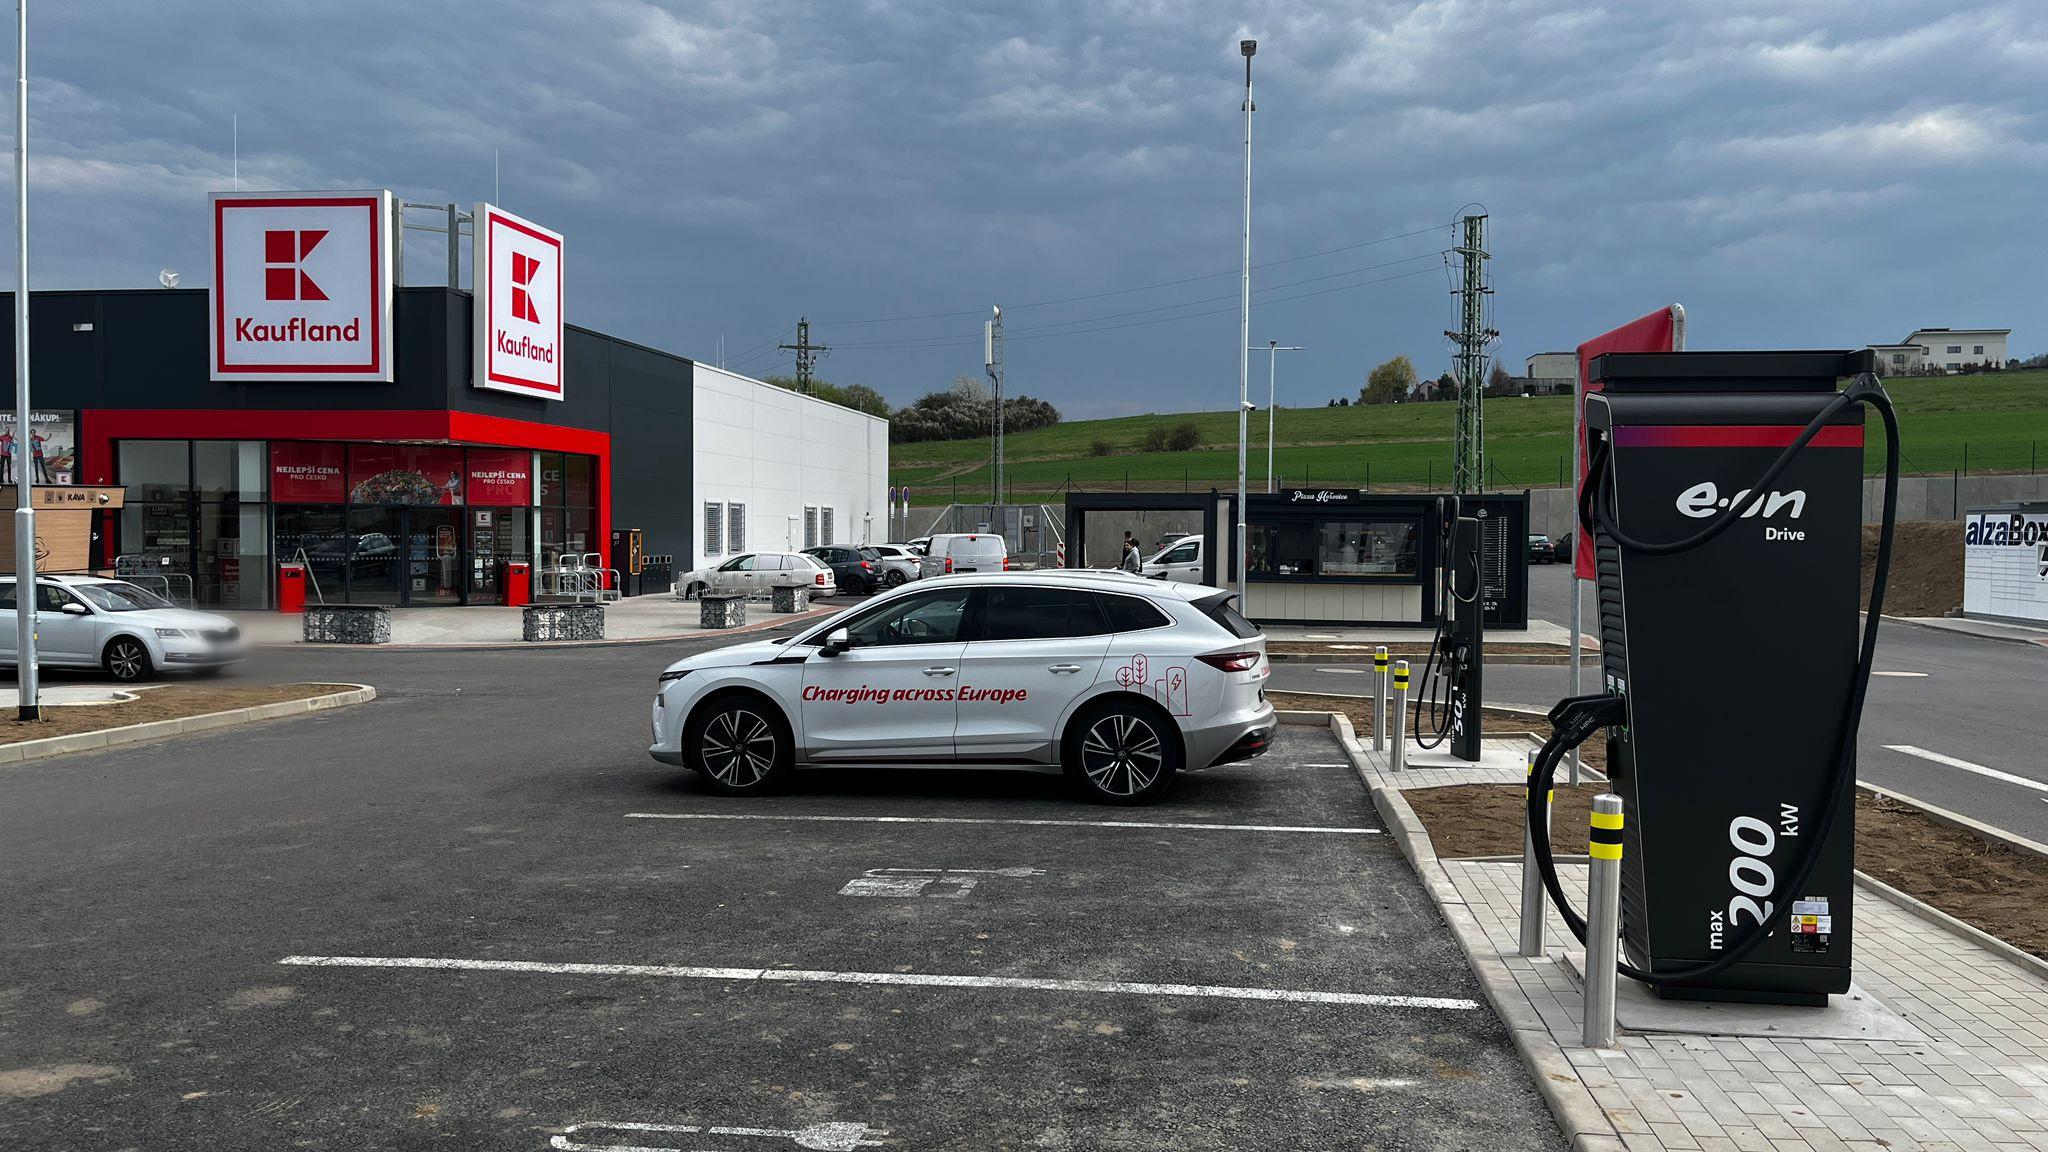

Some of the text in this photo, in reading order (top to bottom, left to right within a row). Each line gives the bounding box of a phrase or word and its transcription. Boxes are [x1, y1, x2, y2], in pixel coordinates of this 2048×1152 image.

[235, 317, 360, 342] Kaufland
[497, 329, 553, 364] Kaufland
[276, 465, 340, 475] NEJLEPŠÍ CENA
[471, 470, 527, 480] NEJLEPŠÍ CENA
[496, 477, 516, 485] ČESKO
[67, 492, 86, 502] KÁVA
[1291, 490, 1349, 503] Pizza Hořovice
[1765, 527, 1806, 541] Drive
[1966, 514, 2048, 547] alzaBox
[801, 684, 1028, 705] Charging across Europe
[1454, 699, 1464, 737] 50
[1579, 716, 1596, 731] HPC
[1710, 802, 1799, 950] max 200 kW
